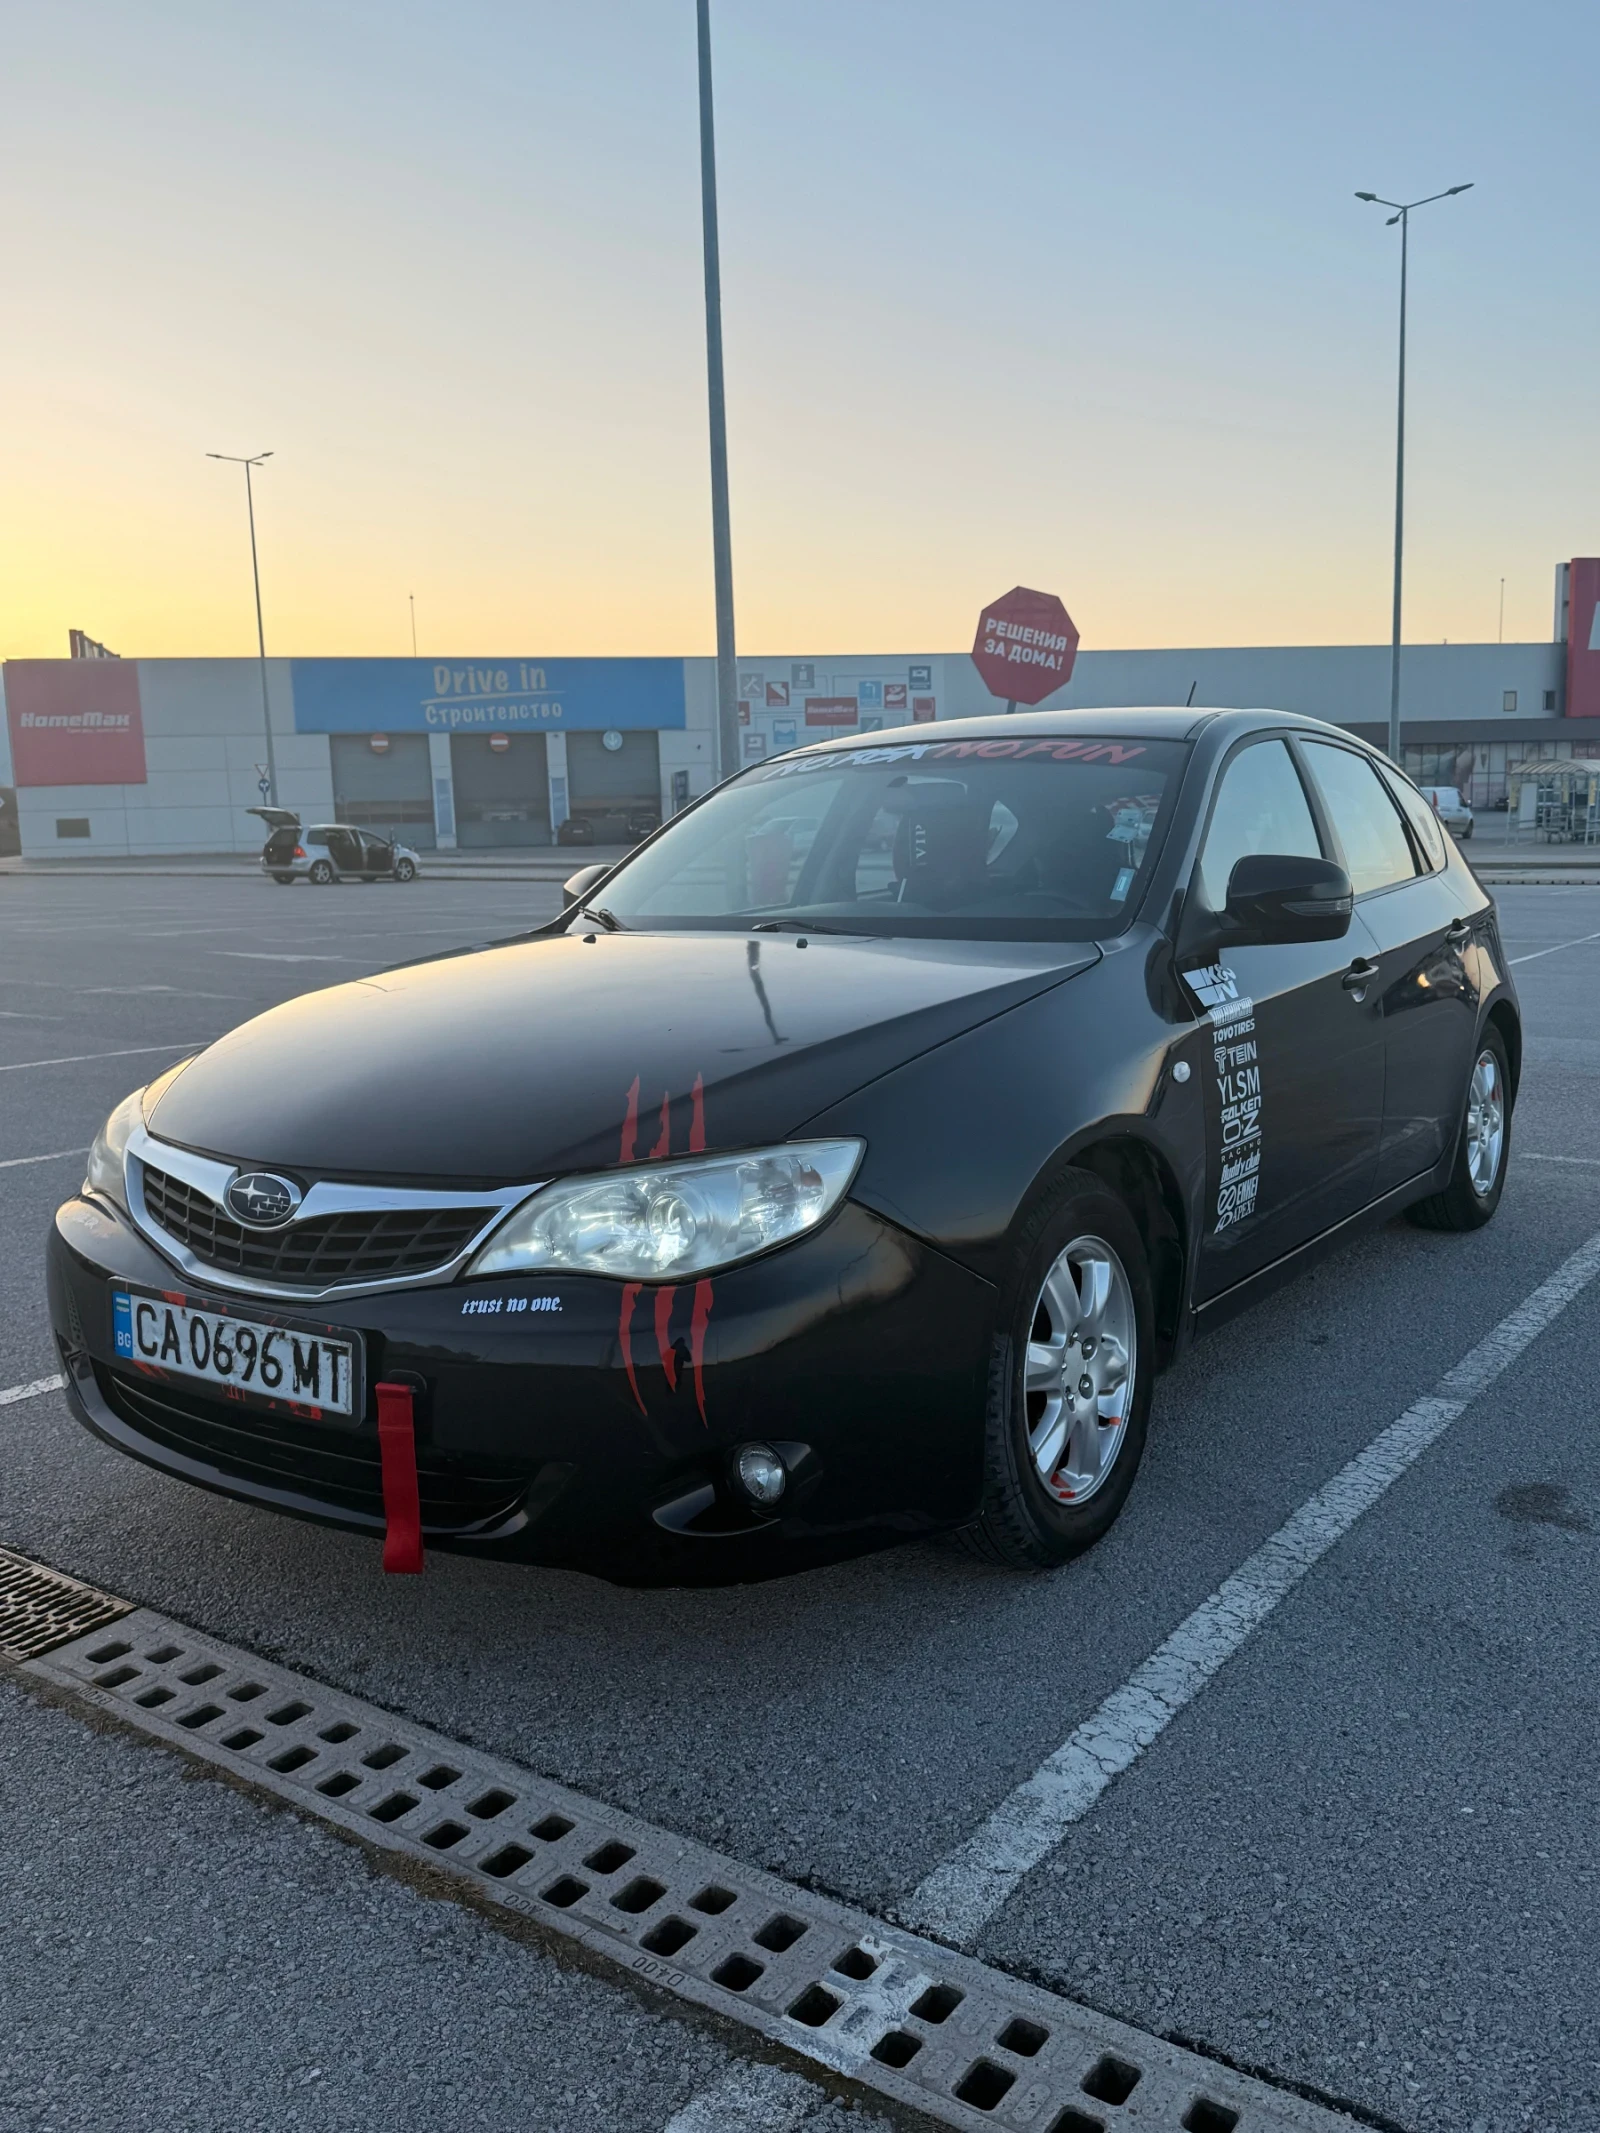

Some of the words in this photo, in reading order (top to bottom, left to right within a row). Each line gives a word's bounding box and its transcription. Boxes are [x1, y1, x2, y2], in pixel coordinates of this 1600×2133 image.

[985, 618, 1068, 652] РЕШЕНИЯ
[984, 639, 1006, 657] ЗА
[1008, 644, 1064, 671] ДОМА!
[433, 664, 509, 695] Drive
[519, 663, 547, 690] in
[20, 711, 130, 728] HomeMax
[425, 701, 563, 727] Строителство
[762, 755, 838, 781] NO
[932, 740, 1024, 759] NO
[1013, 741, 1147, 764] FUN
[1227, 1040, 1257, 1067] TEIN
[1217, 1065, 1261, 1105] YLSM
[1221, 1138, 1262, 1163] RACING
[461, 1296, 503, 1314] trust
[505, 1297, 528, 1313] no
[530, 1296, 564, 1312] one.
[116, 1330, 132, 1348] BG
[631, 1955, 686, 1988] D400
